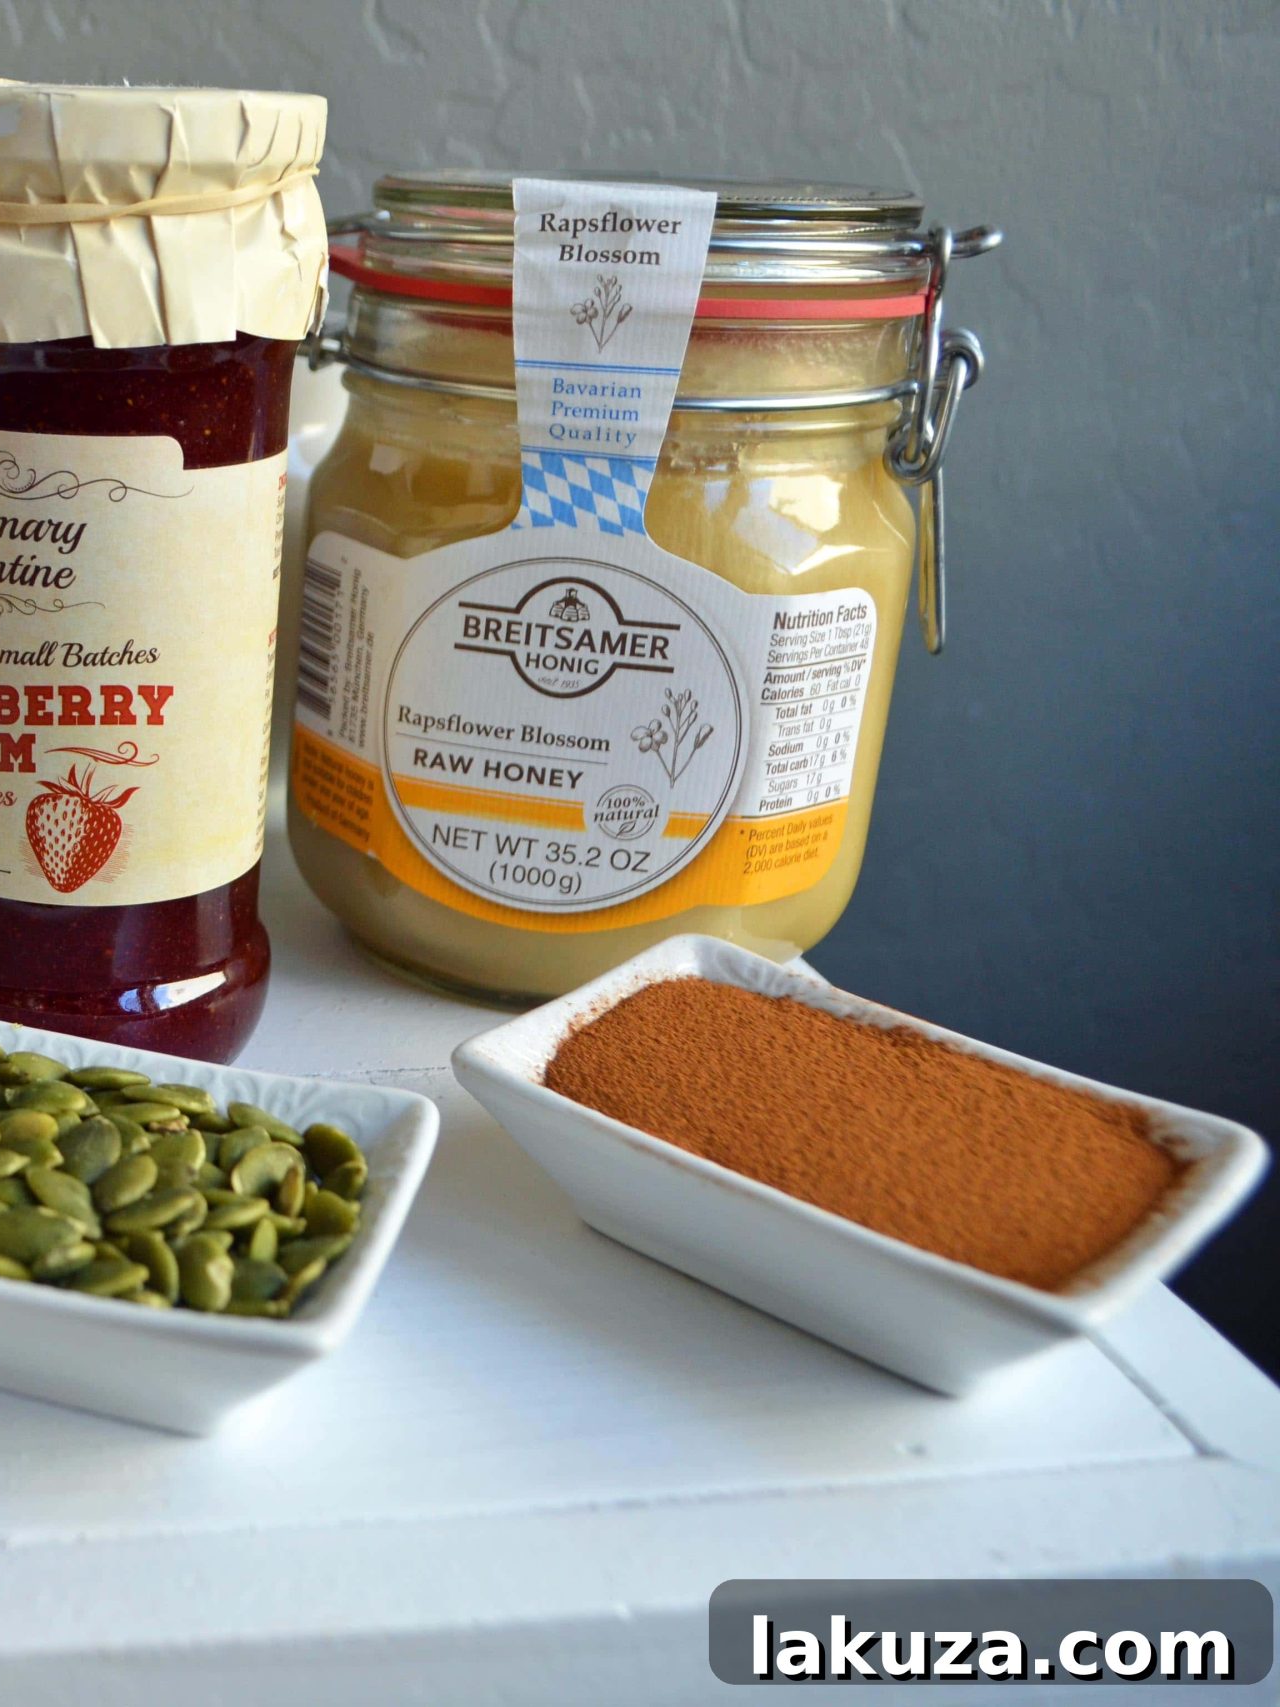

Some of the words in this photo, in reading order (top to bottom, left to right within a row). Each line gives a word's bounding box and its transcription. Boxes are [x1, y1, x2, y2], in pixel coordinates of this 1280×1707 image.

[538, 211, 682, 239] Rapsflower
[557, 244, 662, 266] Blossom
[551, 377, 643, 399] Bavarian
[550, 400, 640, 422] Premium
[548, 423, 638, 449] Quality
[773, 609, 833, 631] Nutrition
[836, 602, 867, 623] Facts
[463, 613, 670, 660] BREITSAMER
[770, 633, 808, 648] Serving
[809, 629, 826, 643] Size
[834, 626, 852, 641] Tbsp
[61, 639, 161, 668] Batches
[767, 650, 809, 664] Servings
[810, 646, 824, 659] Per
[824, 640, 858, 656] Container
[524, 652, 600, 676] HONIG
[763, 670, 805, 685] Amount
[812, 664, 842, 681] serving
[761, 687, 805, 701] Calories
[809, 682, 822, 696] 60
[826, 679, 839, 692] Fat
[840, 676, 852, 690] cal
[775, 705, 798, 719] Total
[800, 703, 813, 716] fat
[397, 704, 515, 741] Rapsflower
[520, 724, 611, 752] Blossom
[778, 724, 800, 738] Trans
[802, 721, 814, 733] fat
[768, 742, 804, 757] Sodium
[412, 748, 474, 775] RAW
[483, 760, 584, 790] HONEY
[766, 761, 789, 775] Total
[790, 757, 808, 772] carb
[768, 778, 798, 794] Sugars
[593, 804, 660, 825] natural
[607, 796, 646, 810] 100%
[759, 797, 793, 812] Protein
[749, 826, 785, 842] Percent
[786, 821, 807, 835] Daily
[809, 814, 833, 829] values
[431, 823, 488, 852] NET
[495, 833, 540, 860] WT
[545, 842, 601, 869] 35.2
[610, 848, 652, 873] OZ
[746, 844, 767, 860] (DV)
[769, 842, 784, 855] are
[785, 834, 810, 850] based
[743, 858, 773, 875] 2,000
[774, 852, 802, 868] calorie
[488, 860, 583, 896] (1000g)
